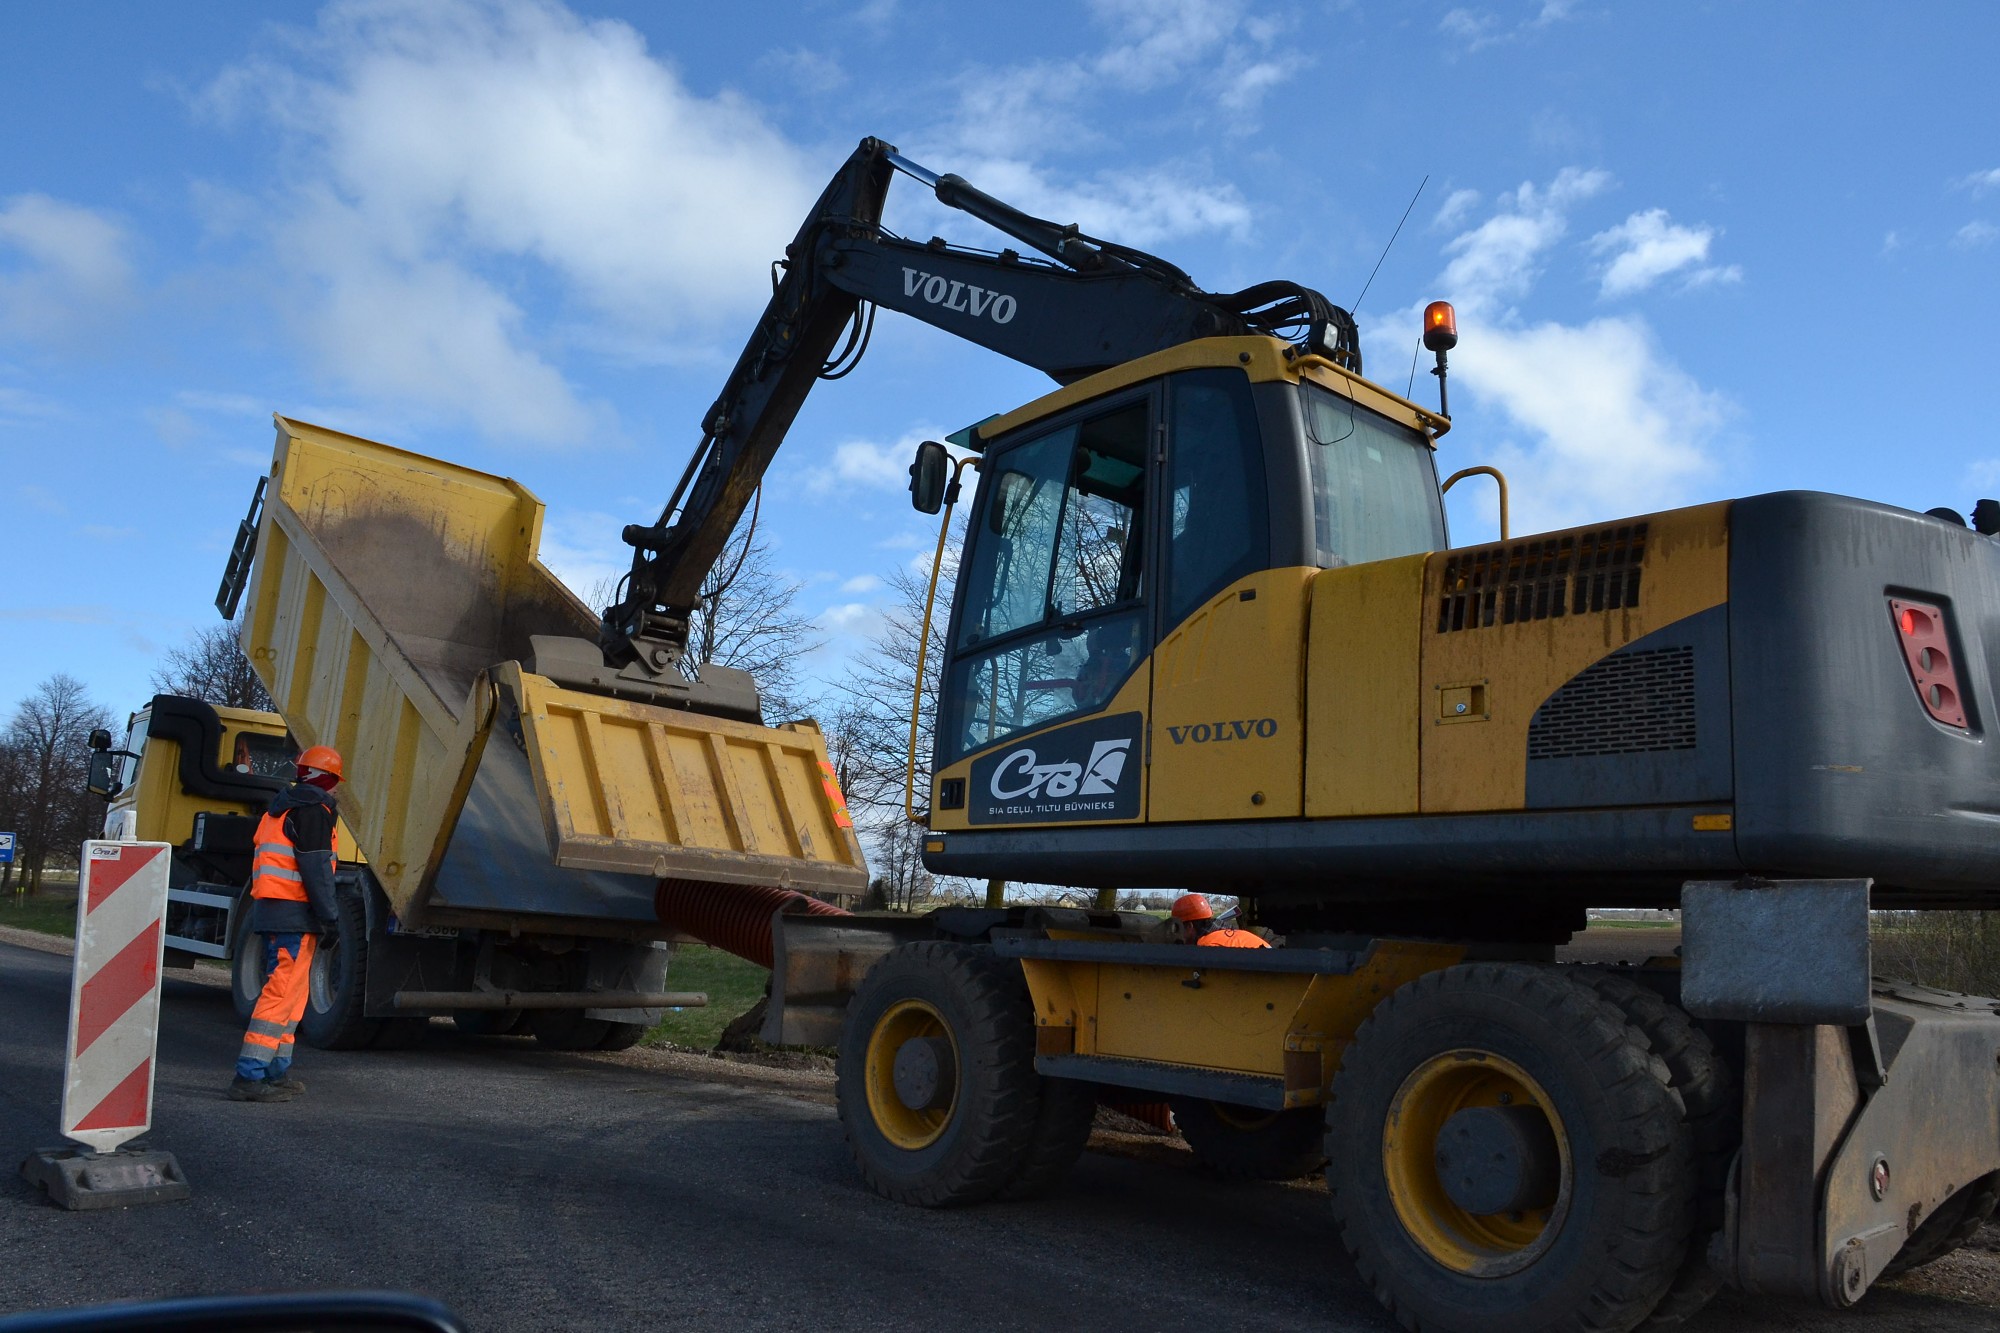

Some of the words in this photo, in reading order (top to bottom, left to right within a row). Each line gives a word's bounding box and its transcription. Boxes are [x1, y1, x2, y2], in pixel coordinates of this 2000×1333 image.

[902, 266, 1017, 324] VOLVO
[1166, 718, 1278, 745] VOLVO
[989, 807, 1004, 815] SIA
[1036, 803, 1061, 813] TILTU
[1064, 801, 1115, 812] BŪVNIEKS
